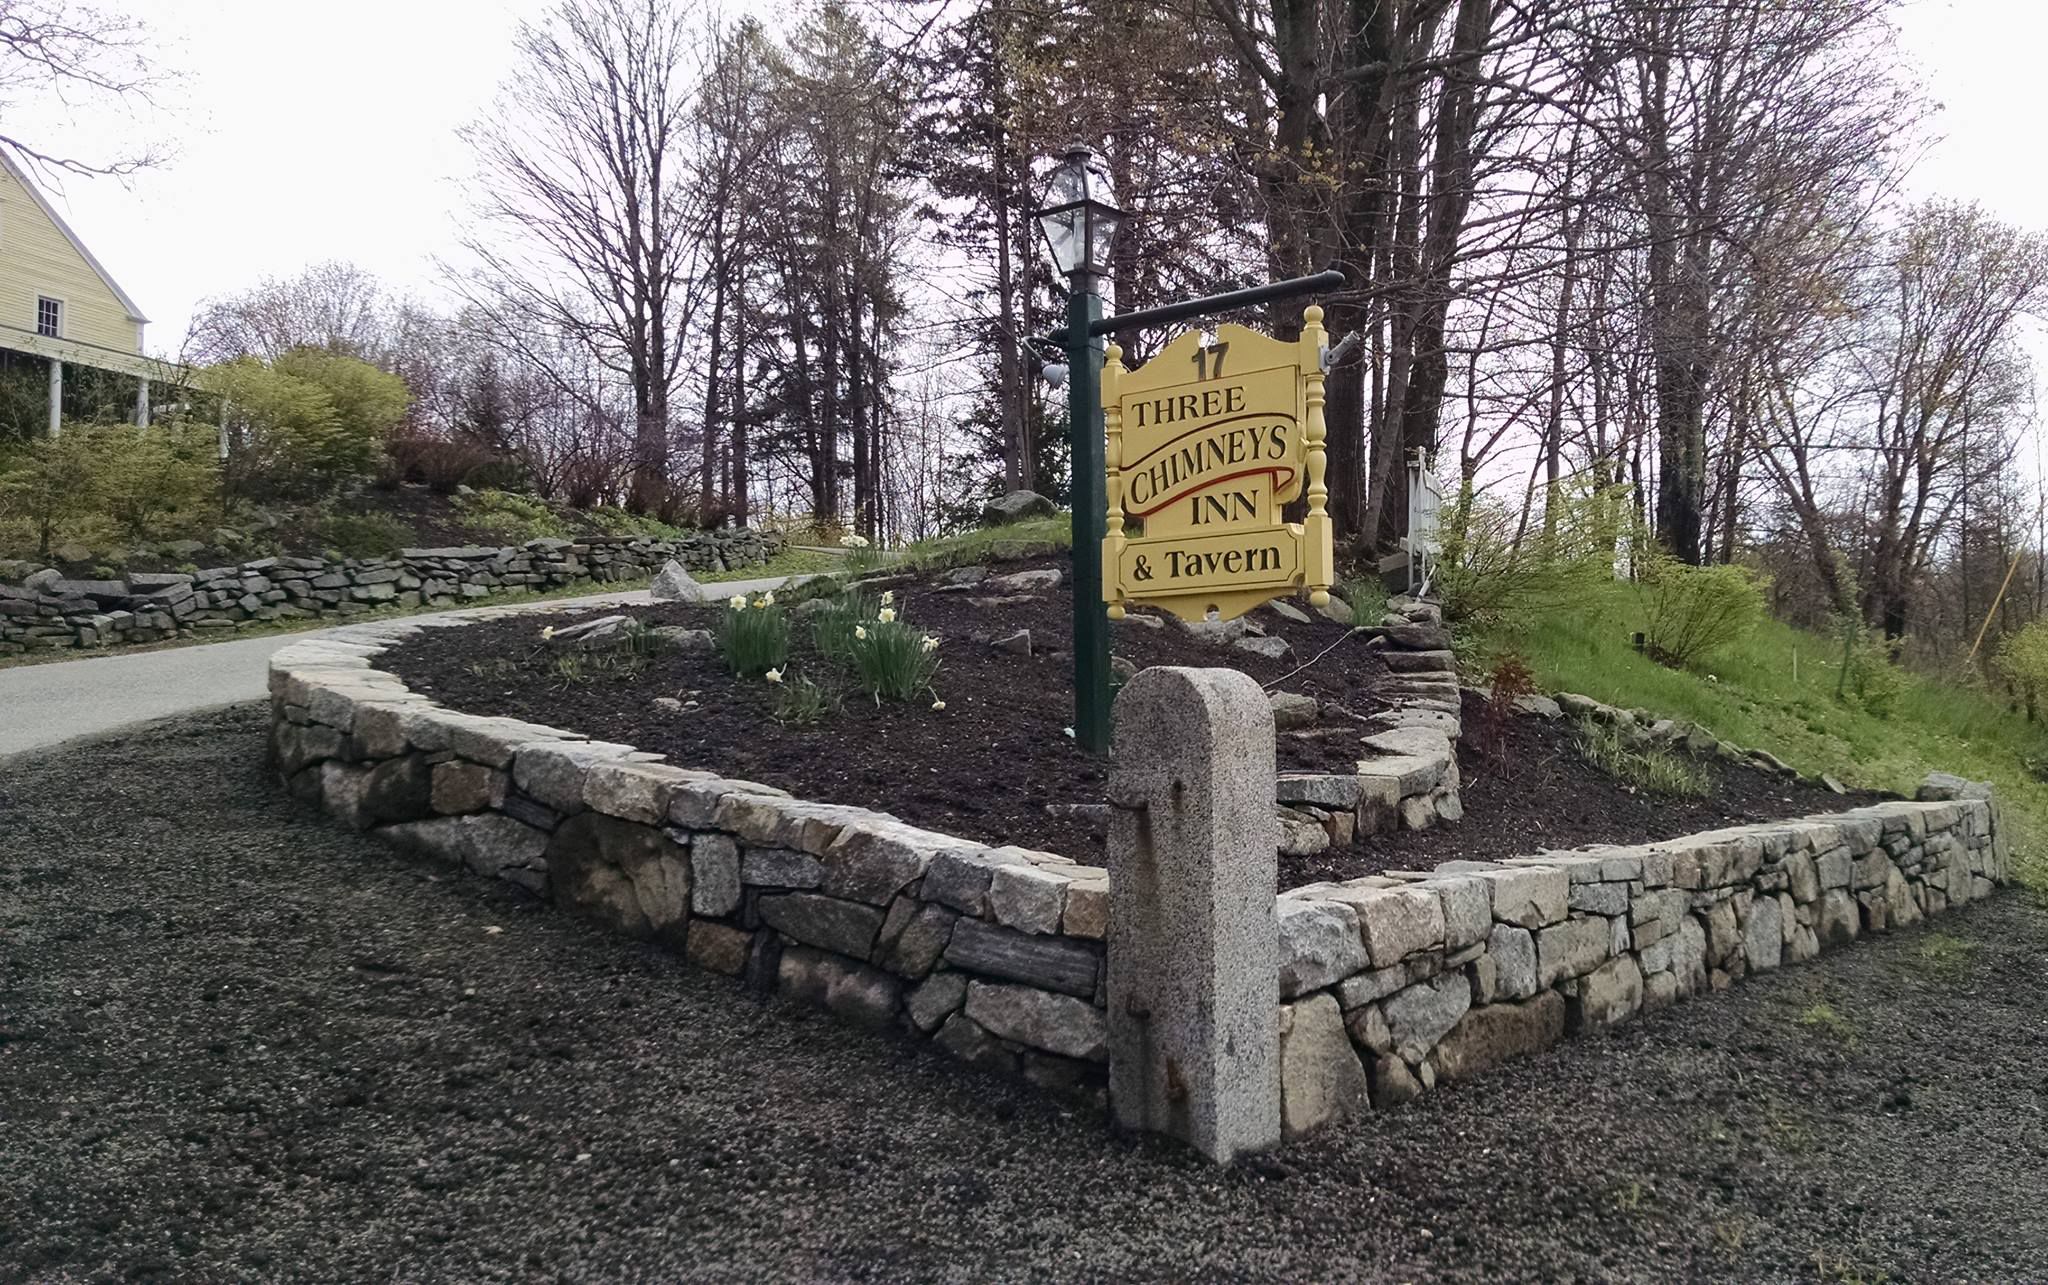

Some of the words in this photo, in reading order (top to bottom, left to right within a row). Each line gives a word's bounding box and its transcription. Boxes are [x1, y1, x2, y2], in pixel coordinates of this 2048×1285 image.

[1192, 342, 1229, 381] 17
[1131, 386, 1246, 428] THREE
[1130, 425, 1287, 505] CHIMNEYS
[1191, 489, 1259, 525] INN
[1133, 554, 1154, 582] &
[1164, 545, 1281, 579] Tavern
